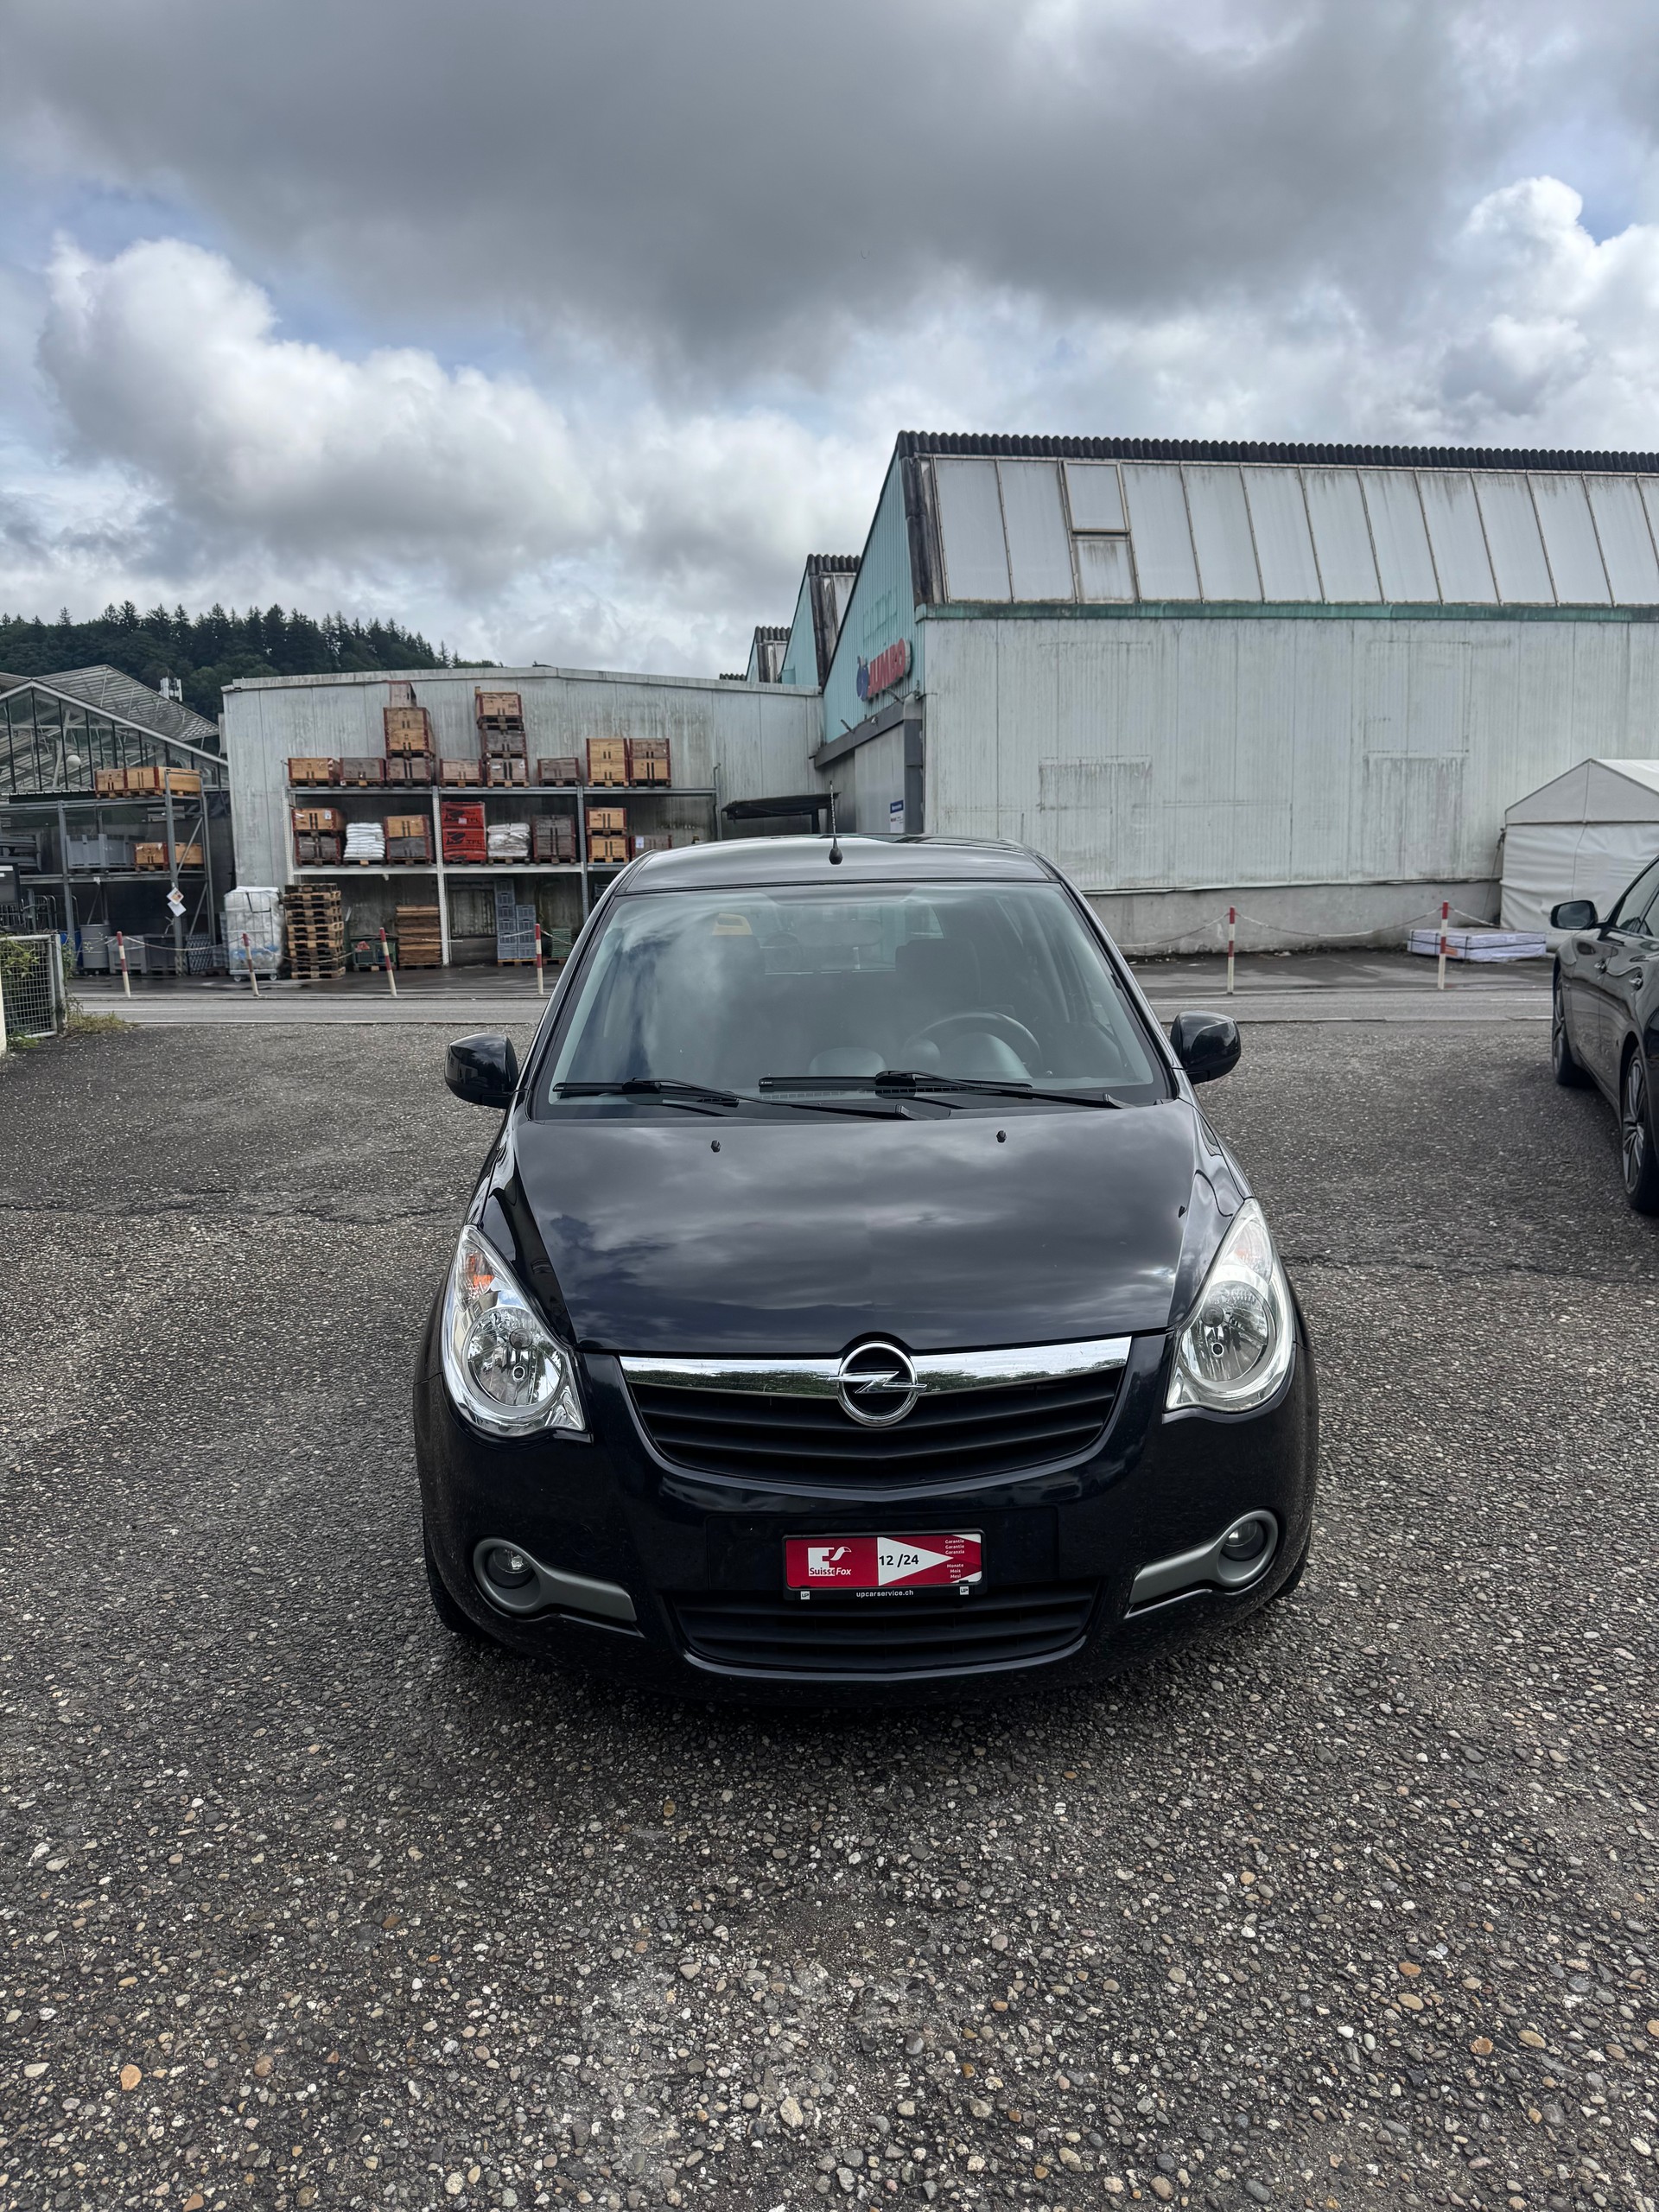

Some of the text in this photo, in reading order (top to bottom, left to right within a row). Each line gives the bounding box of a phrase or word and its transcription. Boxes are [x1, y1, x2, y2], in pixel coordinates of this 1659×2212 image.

[867, 638, 906, 699] JUMBO
[879, 1554, 919, 1567] 12 /24
[855, 1590, 914, 1599] upcarservice.ch
